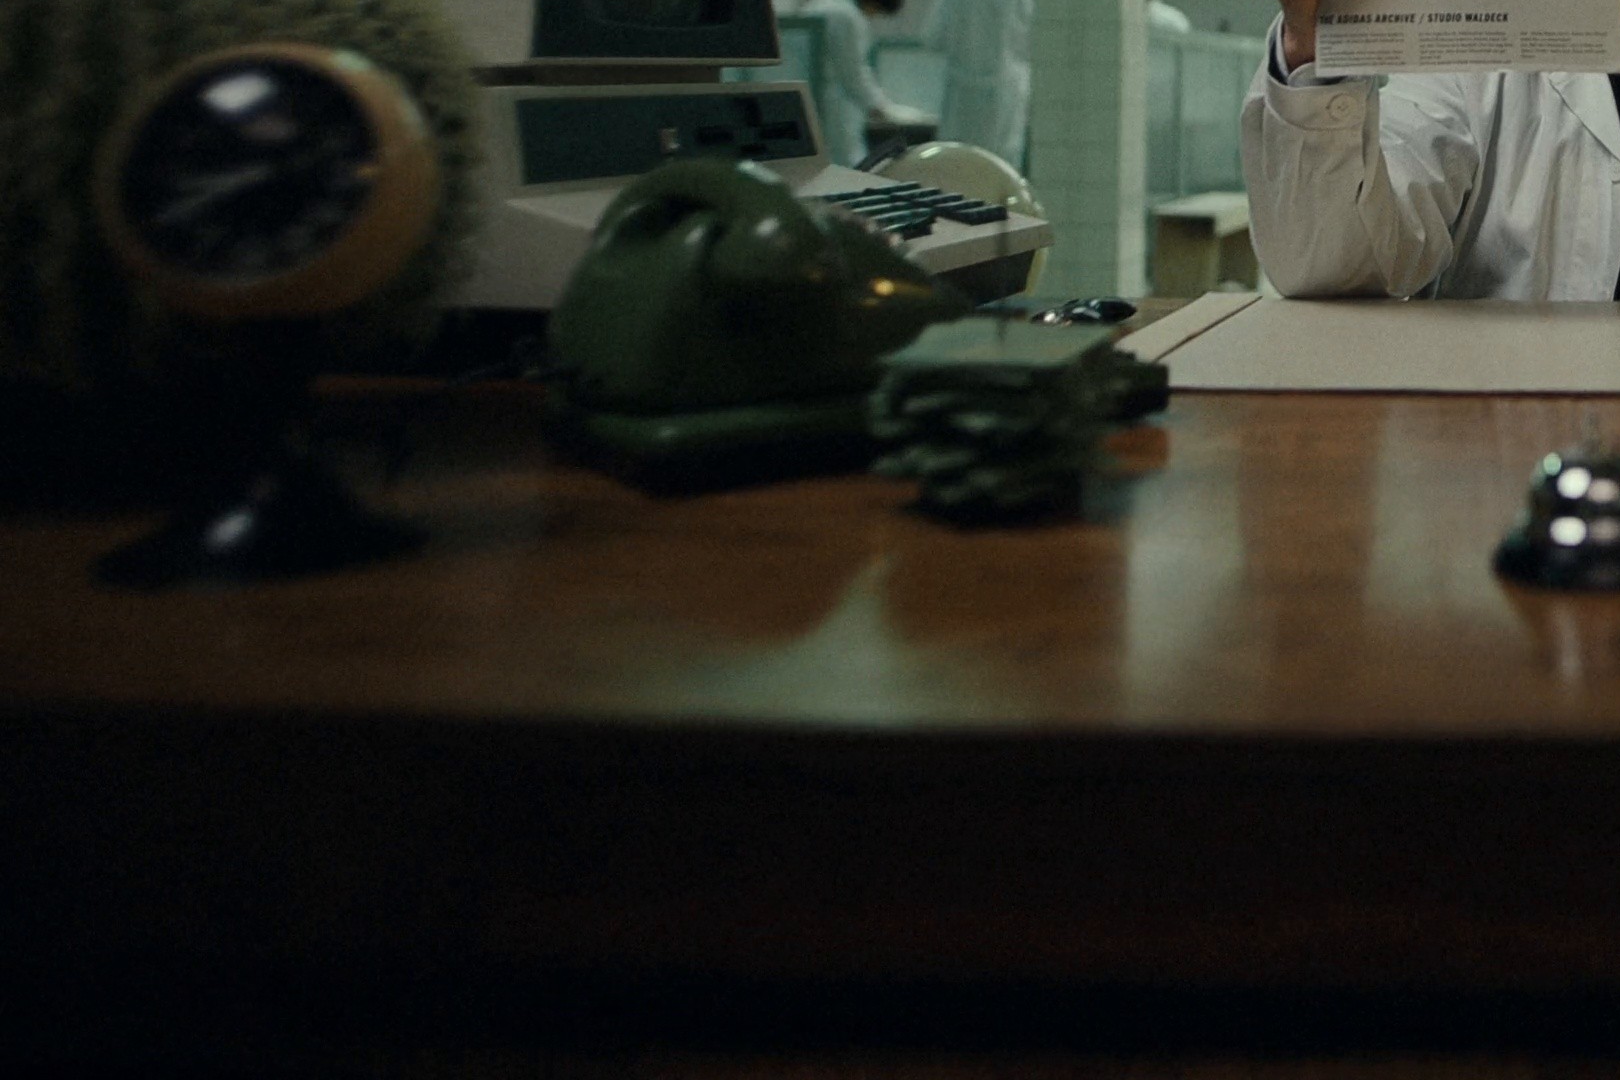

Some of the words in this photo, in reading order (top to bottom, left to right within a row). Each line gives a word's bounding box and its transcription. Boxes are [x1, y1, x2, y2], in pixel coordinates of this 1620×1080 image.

[1337, 14, 1371, 24] ADIDAS
[1374, 13, 1415, 23] ARCHIVE
[1427, 13, 1462, 23] STUDIO
[1465, 12, 1509, 22] WALDECK
